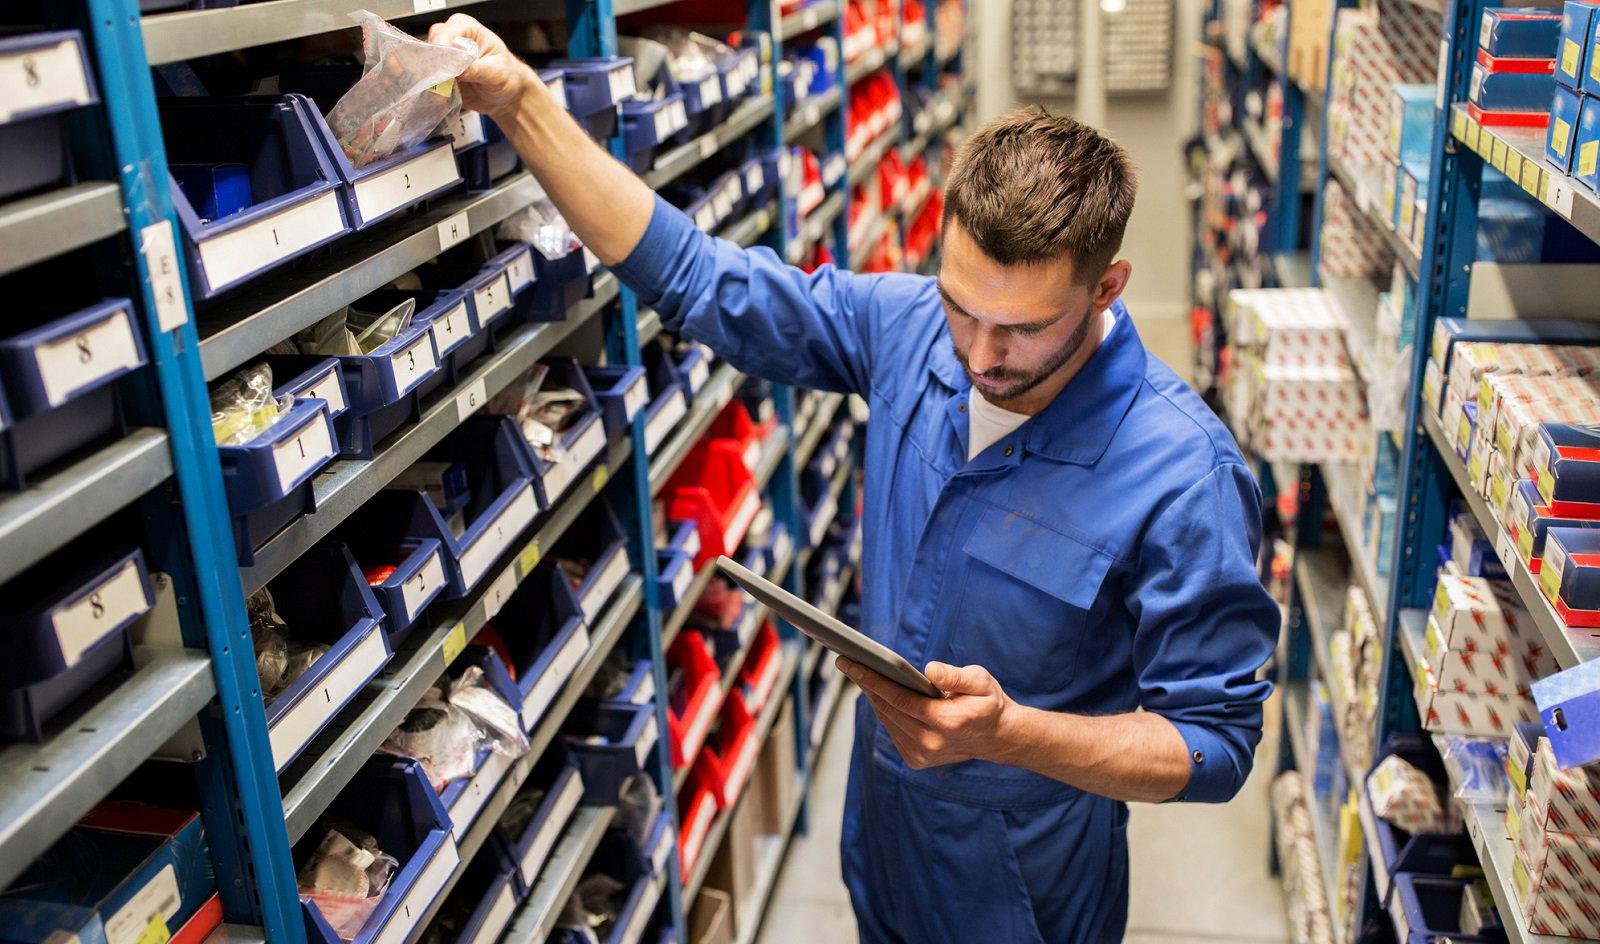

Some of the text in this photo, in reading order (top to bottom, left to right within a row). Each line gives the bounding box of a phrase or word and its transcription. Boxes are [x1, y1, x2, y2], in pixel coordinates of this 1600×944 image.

[403, 173, 411, 189] 2
[272, 228, 279, 246] 1
[451, 223, 460, 240] H
[446, 316, 452, 334] 4
[76, 335, 92, 365] 8
[406, 350, 414, 371] 3
[469, 393, 476, 408] G
[296, 437, 304, 459] 1
[417, 573, 426, 592] 2
[89, 592, 104, 619] 8
[324, 688, 331, 702] 1
[404, 905, 410, 918] 1
